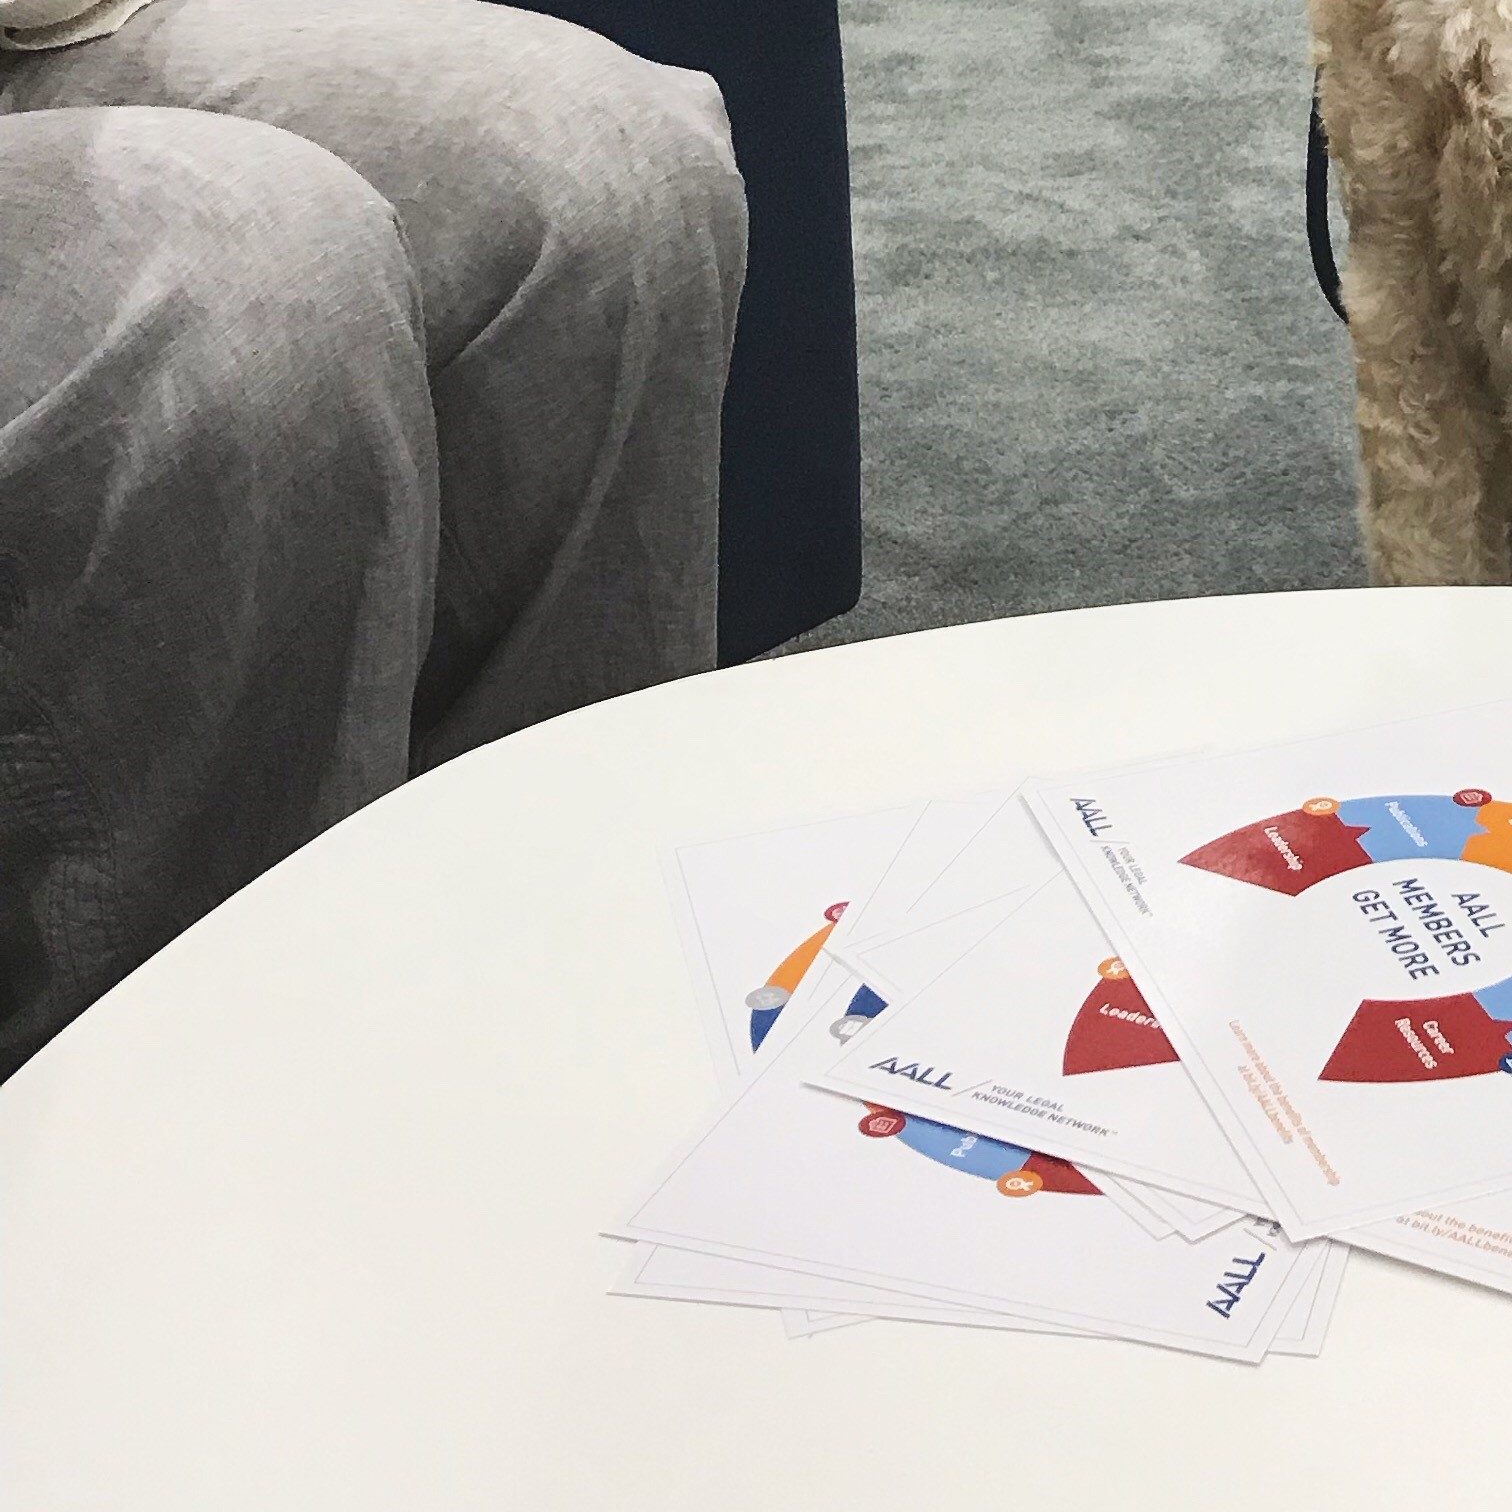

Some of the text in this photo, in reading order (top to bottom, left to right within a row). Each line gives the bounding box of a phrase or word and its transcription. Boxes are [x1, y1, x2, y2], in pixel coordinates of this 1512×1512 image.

[1070, 798, 1113, 836] AALL
[1264, 826, 1304, 871] Leadership
[1352, 890, 1440, 980] GET MORE
[1392, 878, 1481, 967] MEMBERS
[1450, 893, 1505, 938] AALL
[1394, 1017, 1438, 1070] Resources
[1423, 1020, 1455, 1054] Career
[868, 1056, 954, 1091] AALL
[971, 1091, 1048, 1119] KNOWLEDGE
[991, 1084, 1064, 1112] YOUR LEGAL
[1206, 1251, 1266, 1320] AALL
